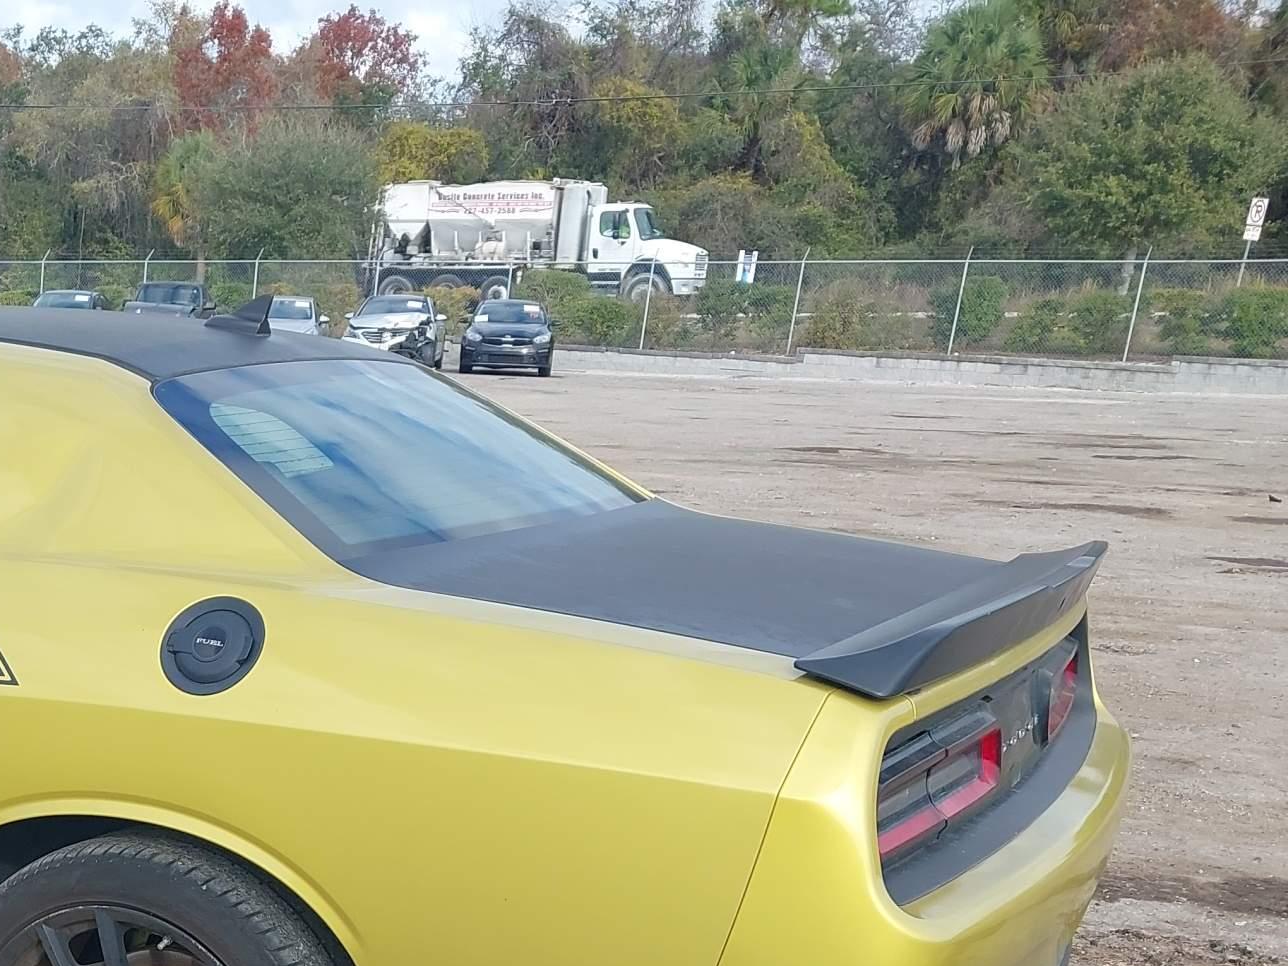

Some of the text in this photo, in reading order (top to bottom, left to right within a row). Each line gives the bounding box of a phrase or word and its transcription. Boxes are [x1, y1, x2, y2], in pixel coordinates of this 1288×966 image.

[463, 192, 495, 200] Concrete
[497, 191, 529, 200] Services
[196, 637, 224, 647] FUEL
